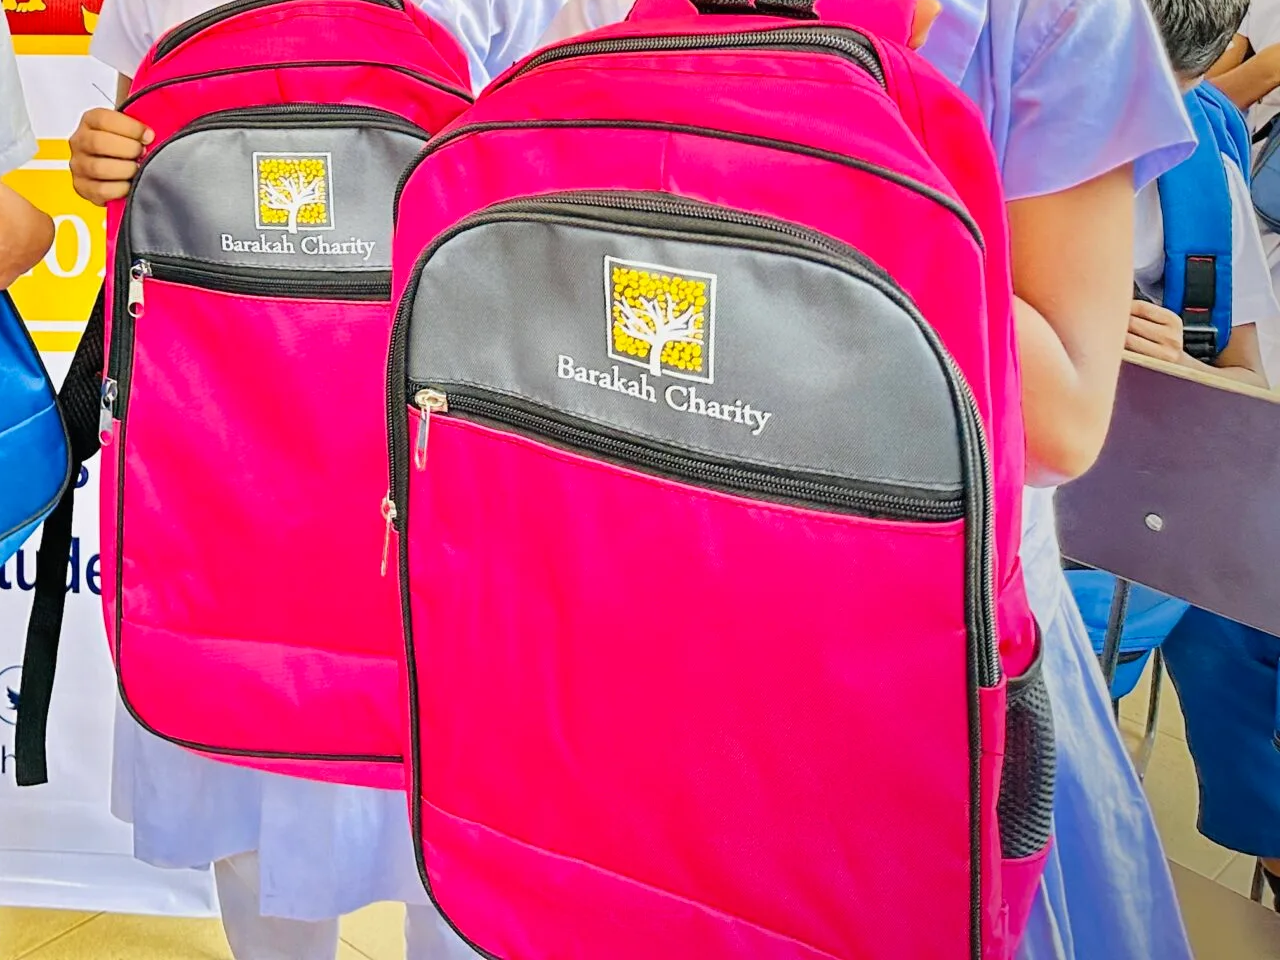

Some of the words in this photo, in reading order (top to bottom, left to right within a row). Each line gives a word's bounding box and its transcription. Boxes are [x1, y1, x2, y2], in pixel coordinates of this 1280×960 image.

[220, 234, 295, 254] Barakah
[301, 236, 376, 260] Charity
[557, 354, 657, 403] Barakah
[664, 385, 772, 435] Charity
